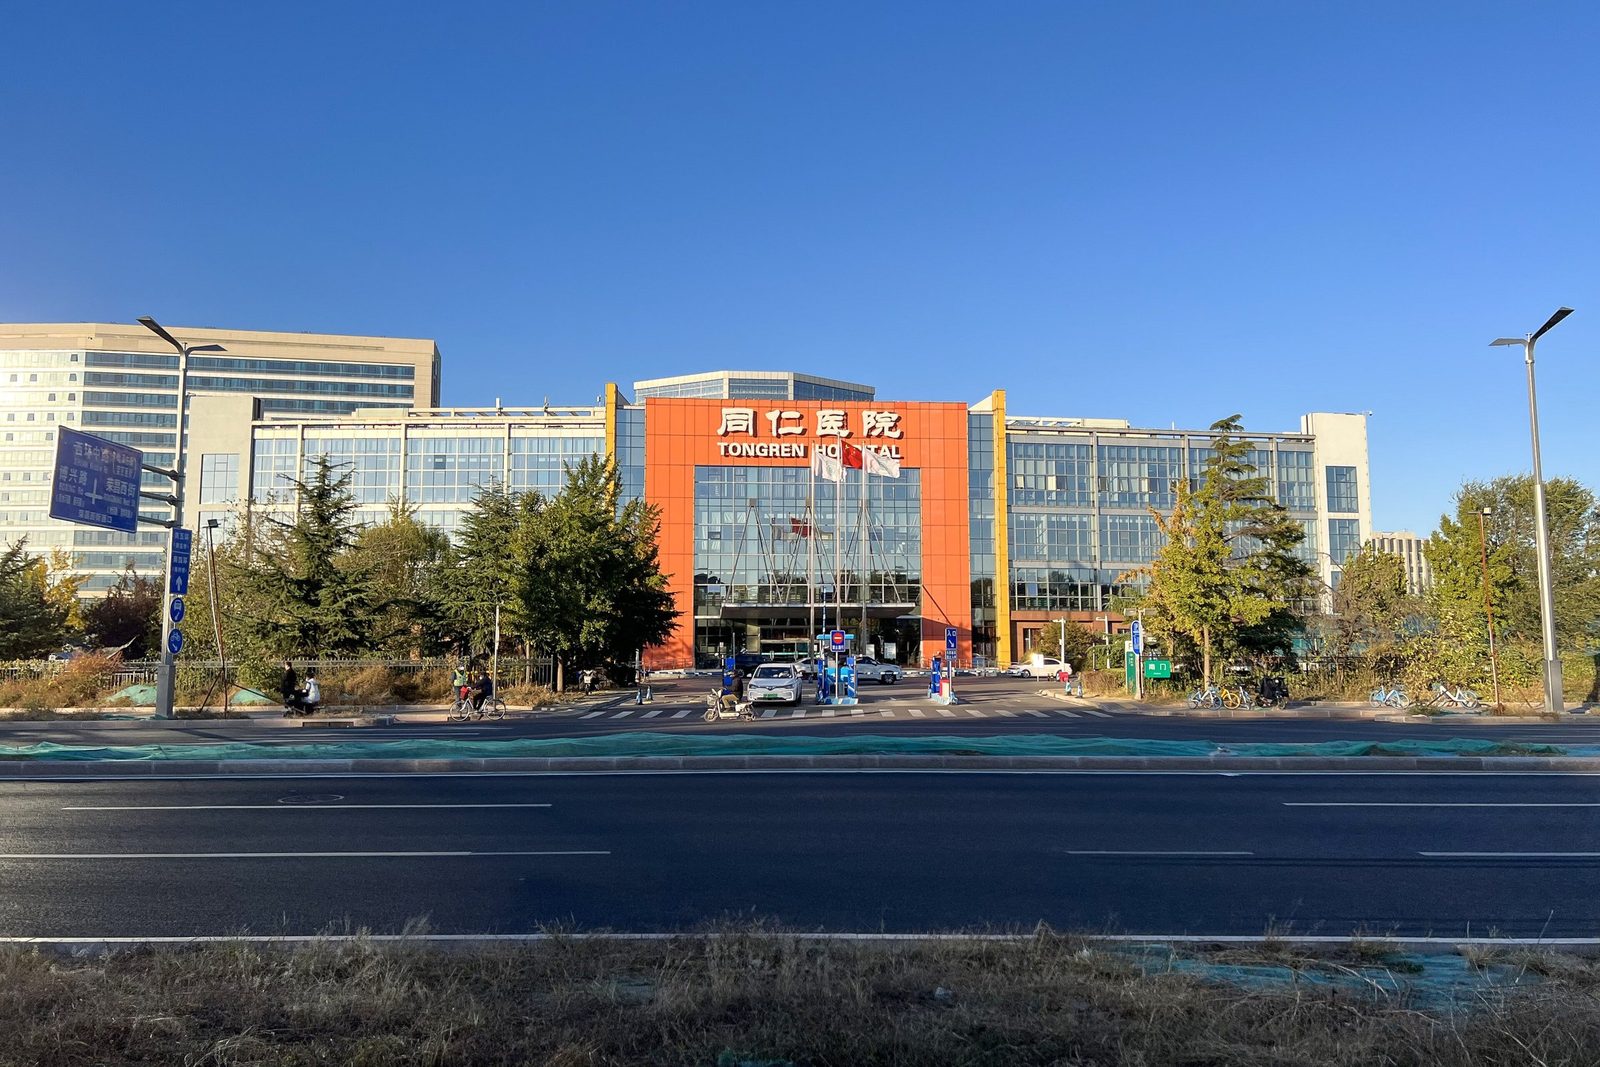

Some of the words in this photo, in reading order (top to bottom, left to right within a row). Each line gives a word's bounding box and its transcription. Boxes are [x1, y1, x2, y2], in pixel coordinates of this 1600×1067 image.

[717, 407, 904, 438] 同仁医院
[717, 442, 805, 457] TONGREN
[814, 444, 901, 459] HOTAL
